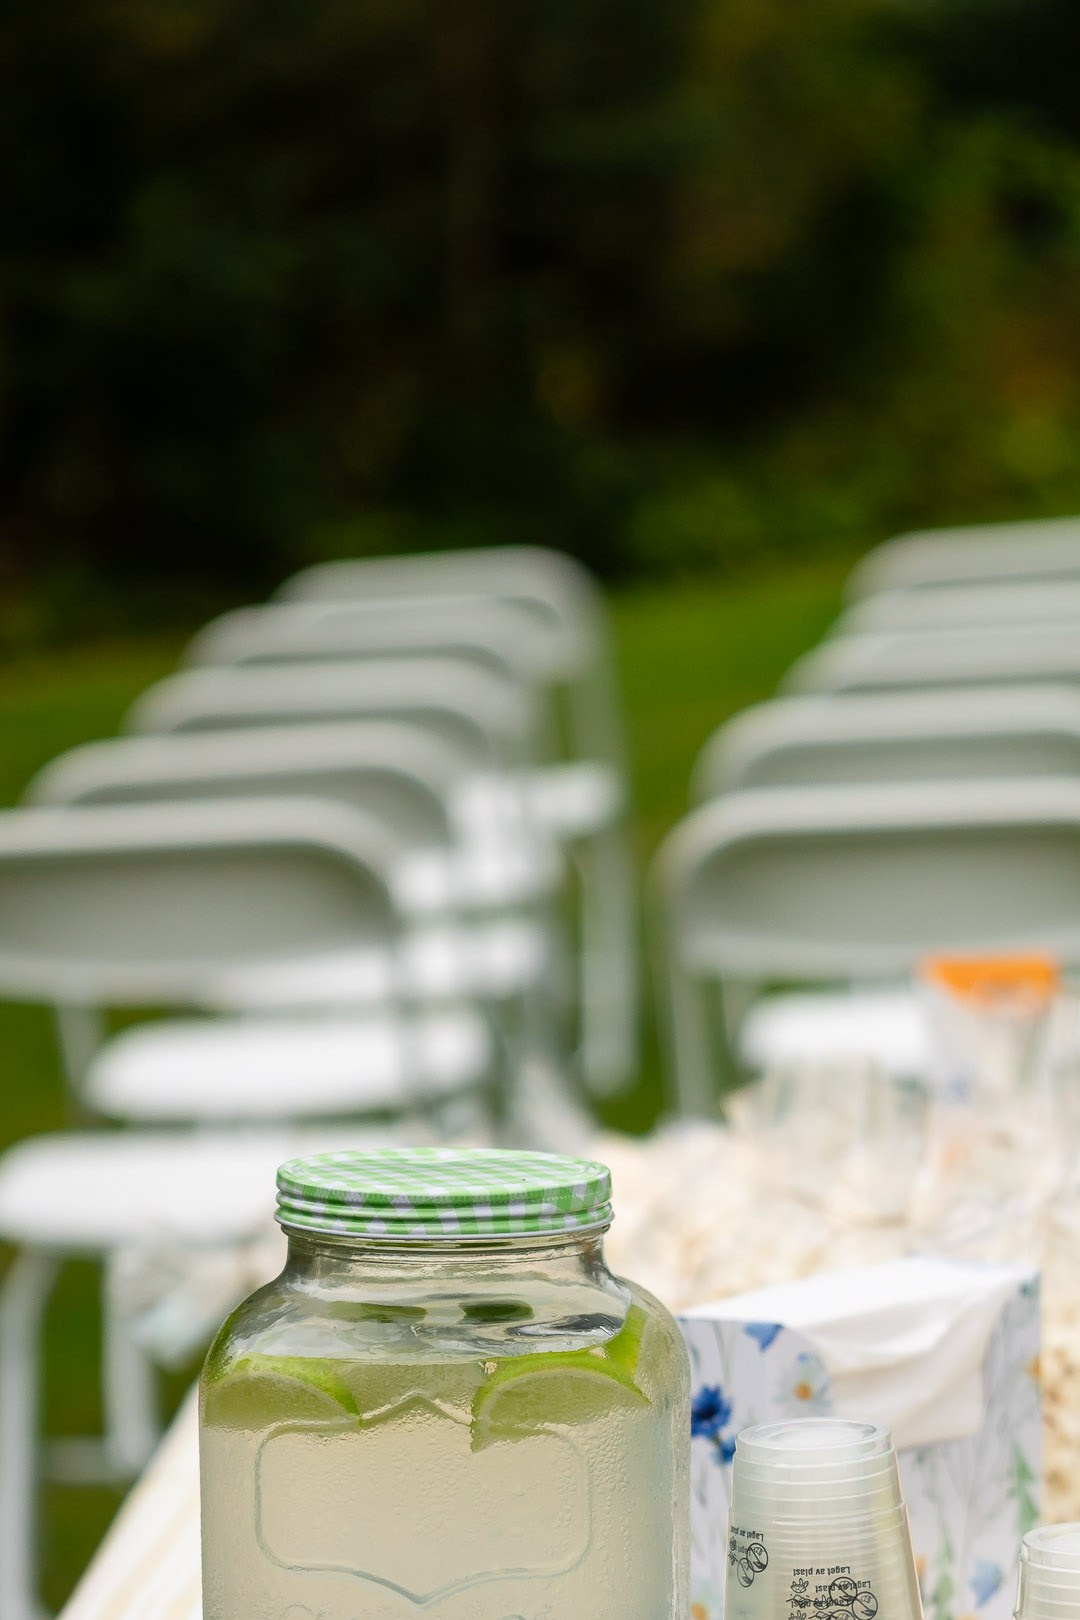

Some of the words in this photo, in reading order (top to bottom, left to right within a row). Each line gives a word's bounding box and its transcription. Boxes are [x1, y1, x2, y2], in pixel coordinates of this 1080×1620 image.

[746, 1531, 764, 1542] Laget
[792, 1567, 813, 1577] plast
[828, 1566, 851, 1575] Laget
[815, 1583, 836, 1593] plast
[849, 1580, 871, 1590] Laget
